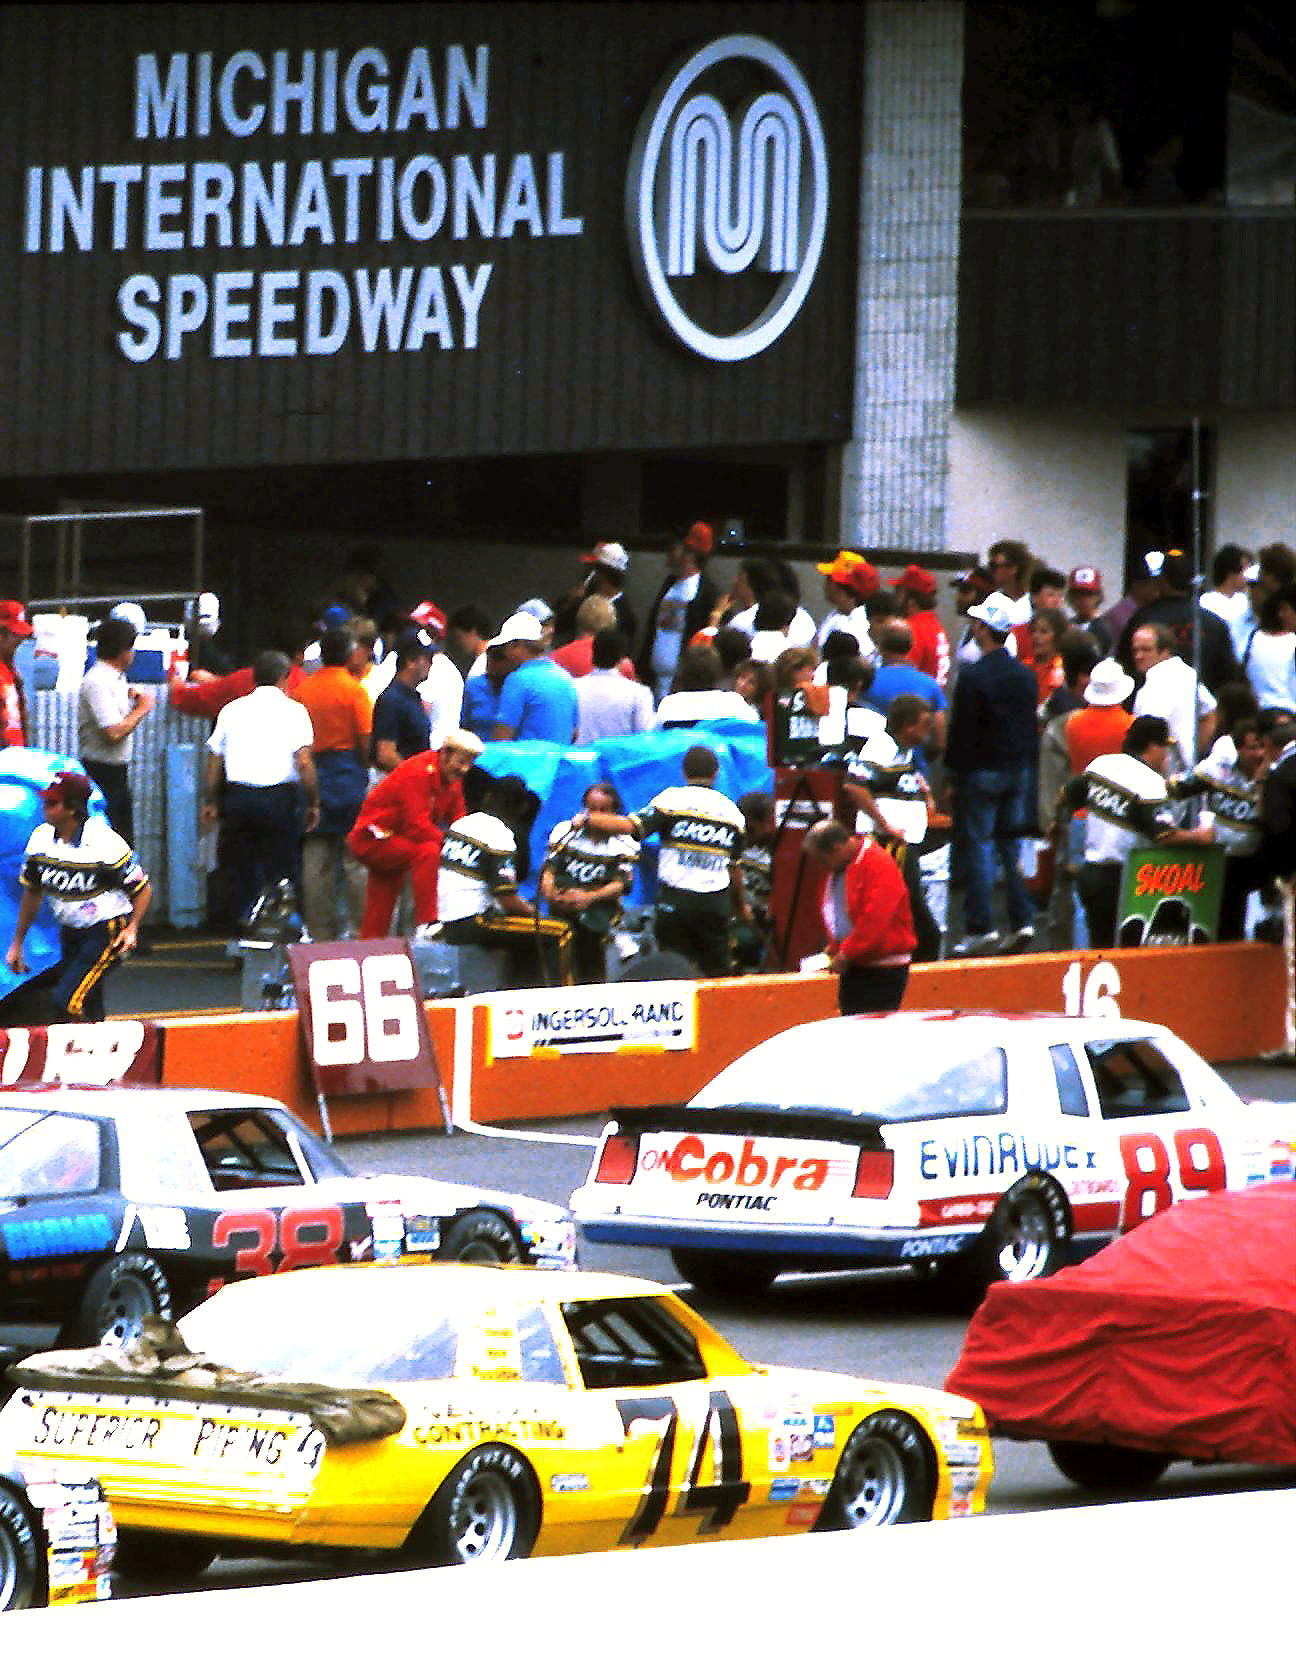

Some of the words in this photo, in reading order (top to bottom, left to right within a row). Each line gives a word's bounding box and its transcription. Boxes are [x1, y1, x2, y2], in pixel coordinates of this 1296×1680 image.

[134, 44, 491, 141] MICHIGAN
[24, 152, 585, 254] INTERNATIONAL
[117, 264, 494, 363] SPEEDWAY
[671, 820, 736, 847] SKOAL
[1135, 863, 1205, 897] SKOAL
[308, 954, 420, 1067] 66
[1062, 961, 1122, 1019] 16
[671, 1134, 831, 1191] Cobra
[696, 1192, 777, 1211] PONTIAC
[1118, 1127, 1227, 1233] 89
[212, 1204, 344, 1298] 38
[616, 1390, 751, 1549] 74
